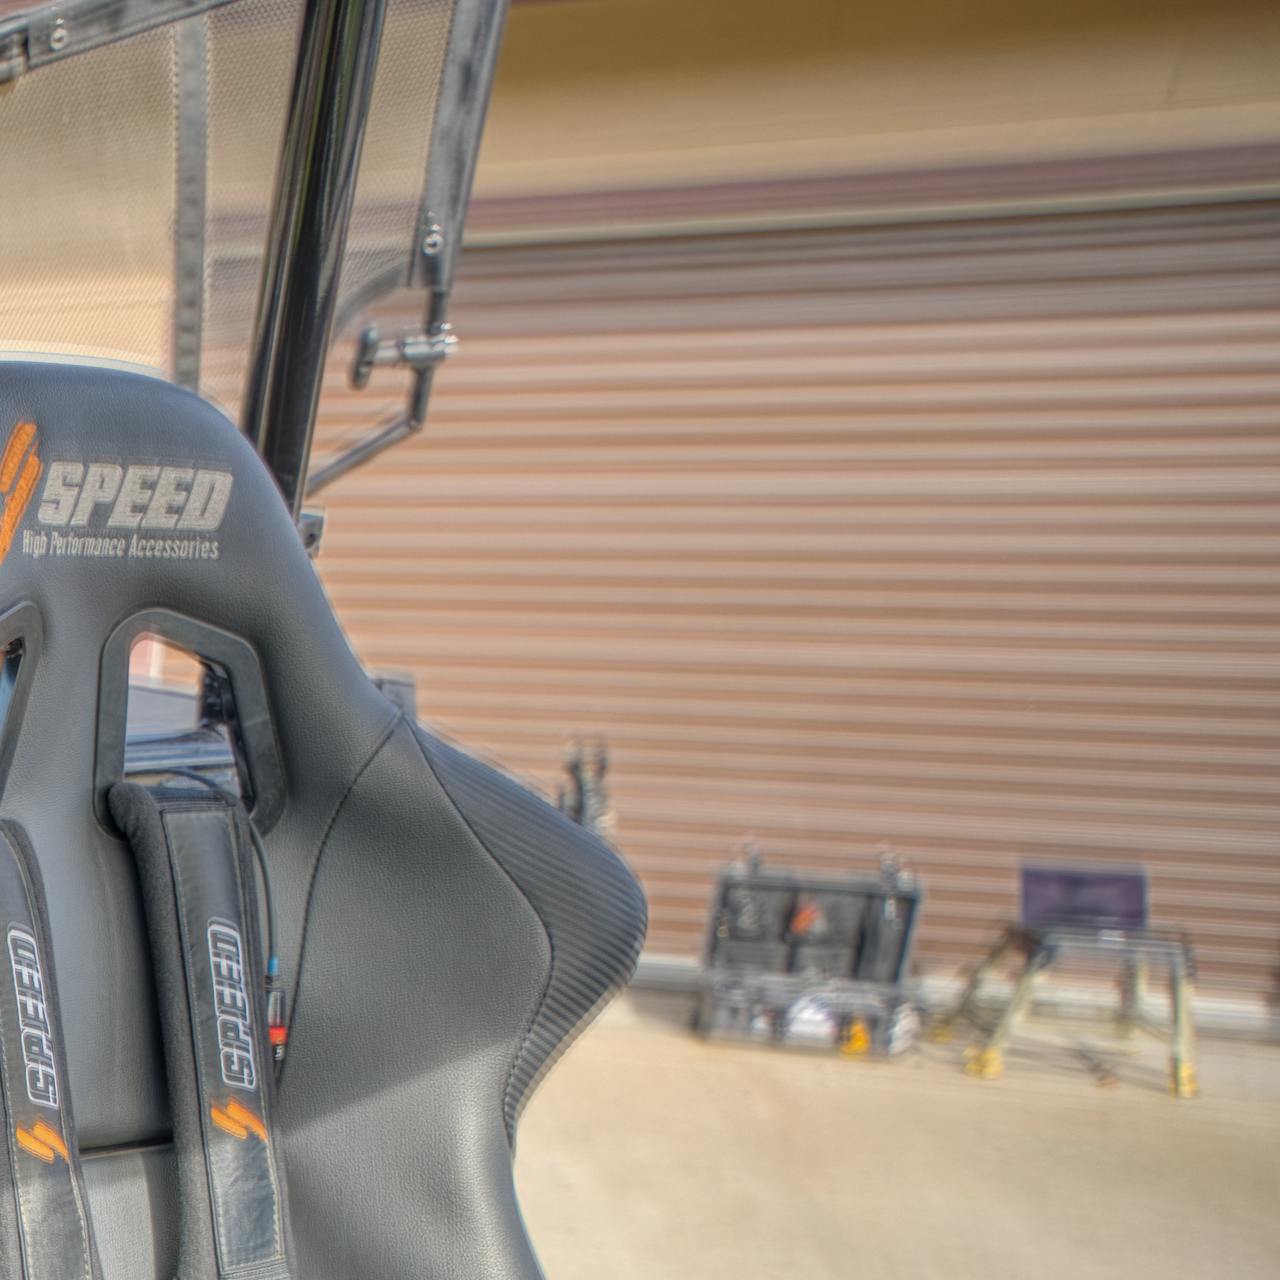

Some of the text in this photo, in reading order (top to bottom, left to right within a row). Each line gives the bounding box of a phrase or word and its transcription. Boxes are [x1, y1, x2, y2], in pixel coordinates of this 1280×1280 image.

[22, 529, 220, 561] High Performance Accessories
[37, 460, 234, 531] SPEED
[7, 927, 60, 1110] SPEED
[207, 923, 257, 1090] SPEED
